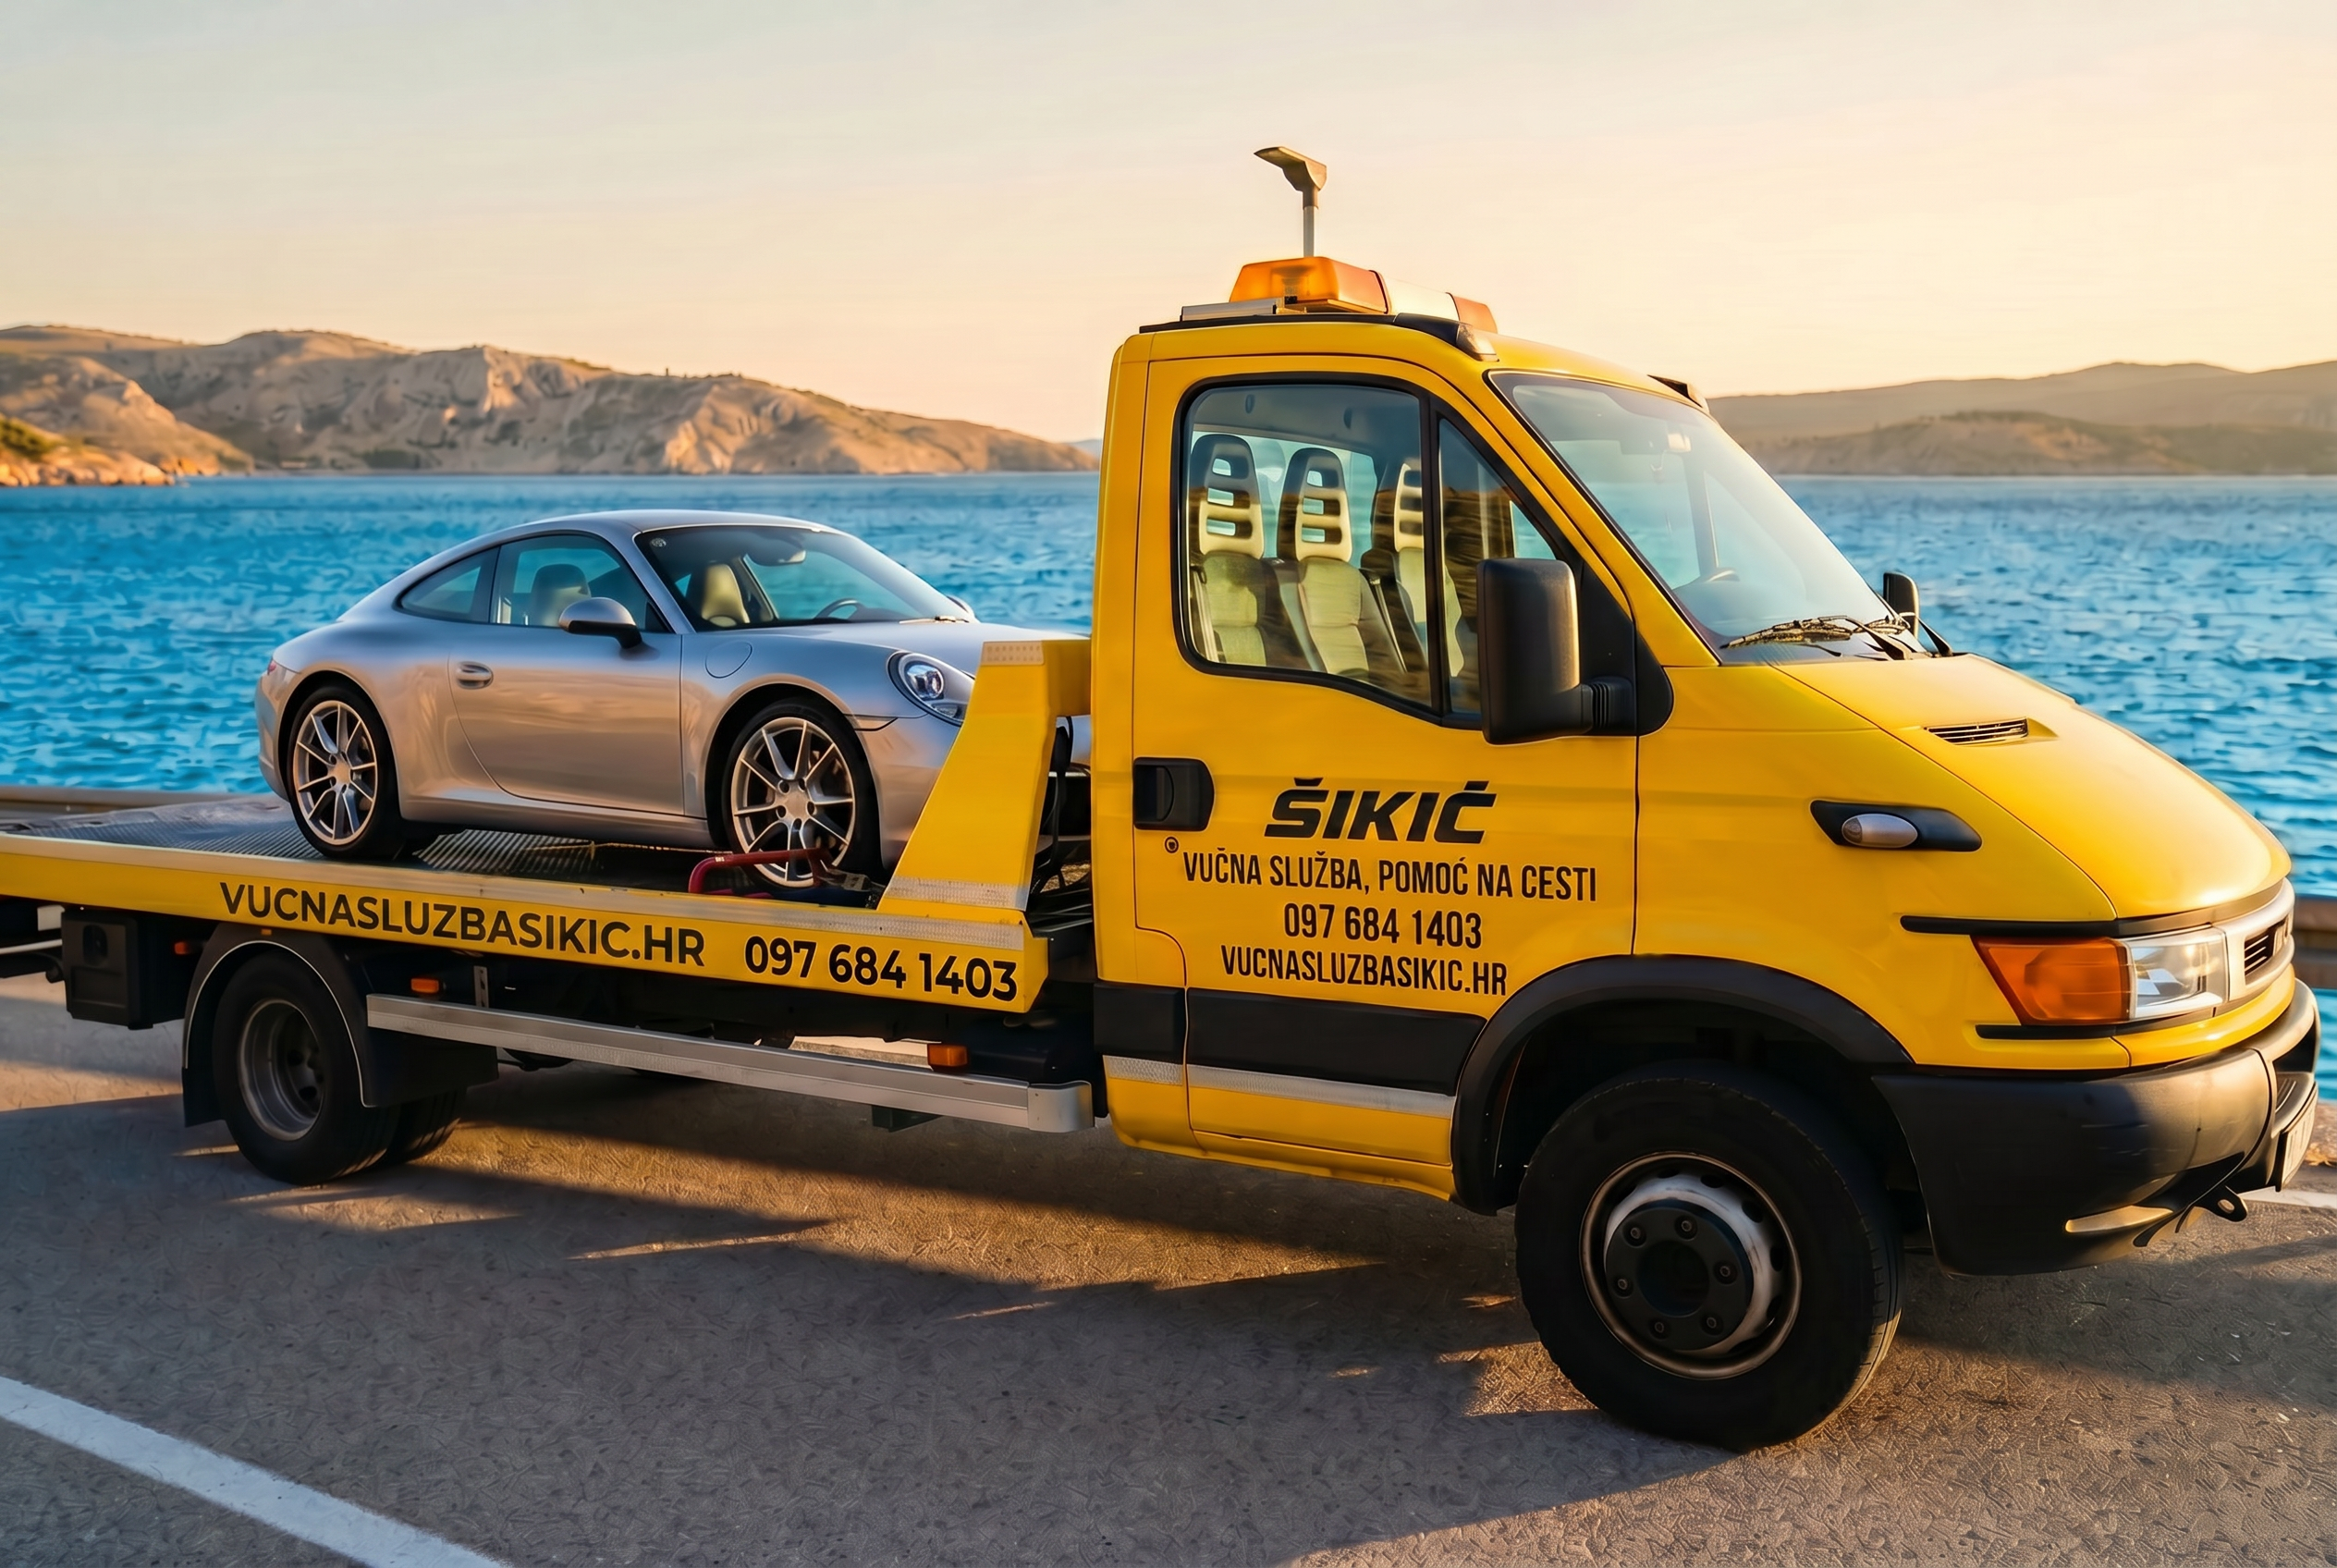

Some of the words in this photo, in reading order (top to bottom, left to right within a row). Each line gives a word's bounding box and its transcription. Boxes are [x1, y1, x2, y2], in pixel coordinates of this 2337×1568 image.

[1264, 777, 1498, 844] ŠIKIĆ
[1182, 847, 1262, 886] VUČNA
[1269, 851, 1370, 895] SLUŽBA,
[1378, 856, 1469, 895] POMOĆ
[1477, 864, 1513, 898] NA
[1521, 864, 1597, 901] CESTI
[219, 881, 705, 967] VUCNASLUZBASIKIC.HR
[744, 936, 817, 978] 097
[828, 943, 907, 989] 684
[918, 952, 1018, 1002] 1403
[1284, 902, 1335, 938] 097
[1344, 906, 1401, 944] 684
[1412, 910, 1483, 950] 1403
[1220, 945, 1507, 996] VUCNASLUZBASIKIC.HR
